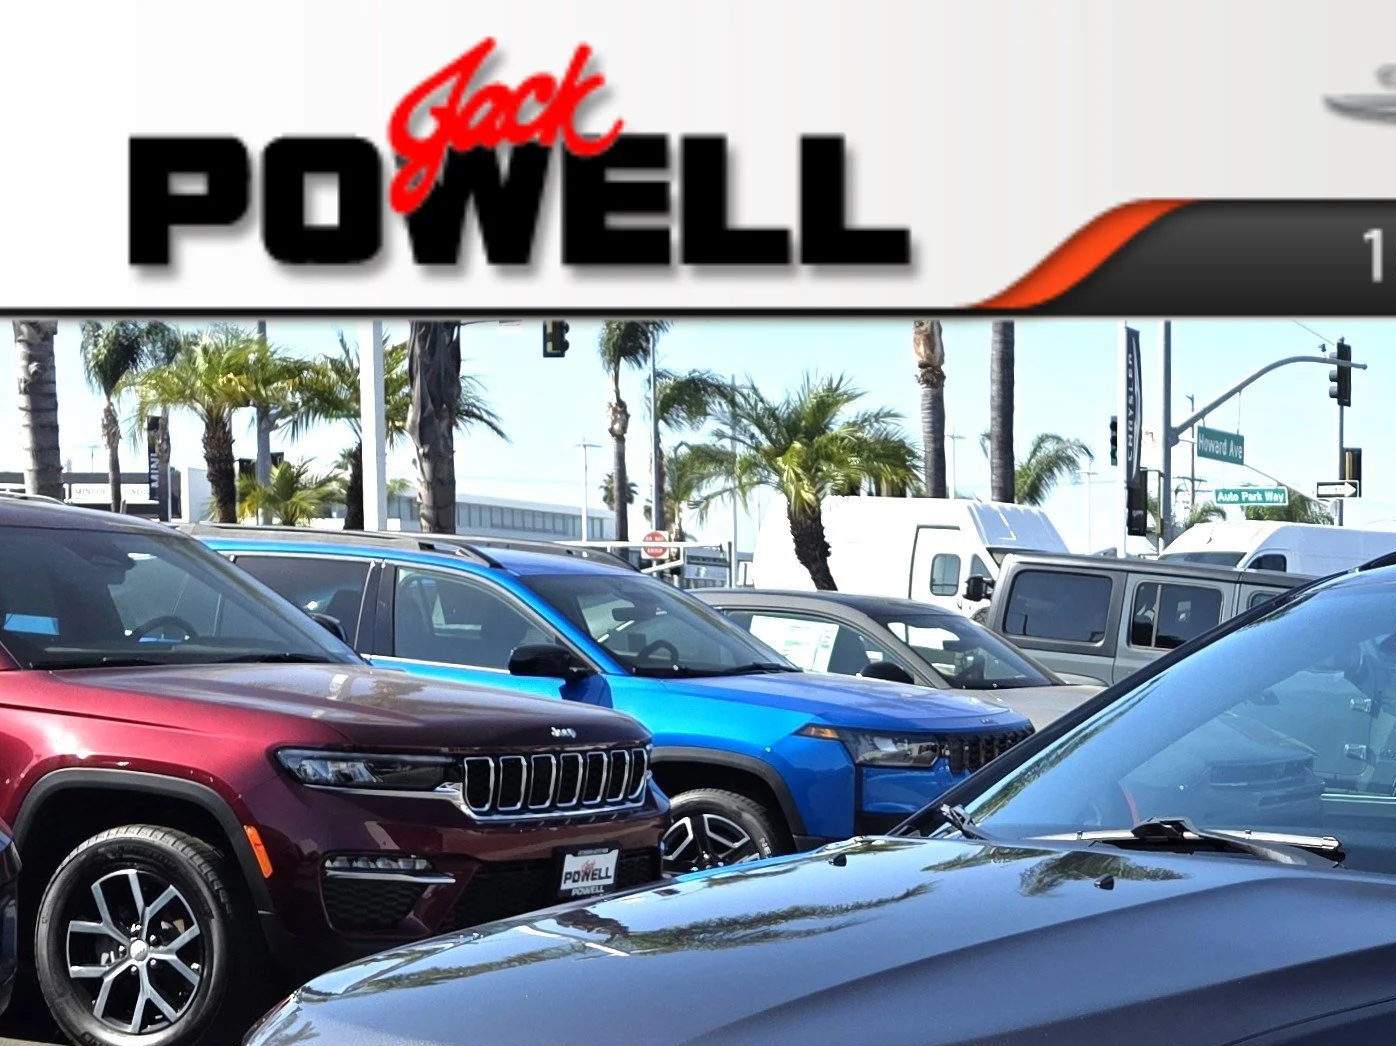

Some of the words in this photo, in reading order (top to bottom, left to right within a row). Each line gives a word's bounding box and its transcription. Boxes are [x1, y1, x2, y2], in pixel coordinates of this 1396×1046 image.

[1127, 353, 1135, 462] CHRYSLER
[1198, 434, 1228, 456] Howard
[1229, 440, 1243, 460] Ave
[150, 453, 160, 488] MINI
[1217, 491, 1239, 502] Auto
[1241, 491, 1263, 502] Park
[1264, 491, 1285, 503] Way
[564, 867, 612, 884] POWELL
[571, 885, 604, 896] POWELL
